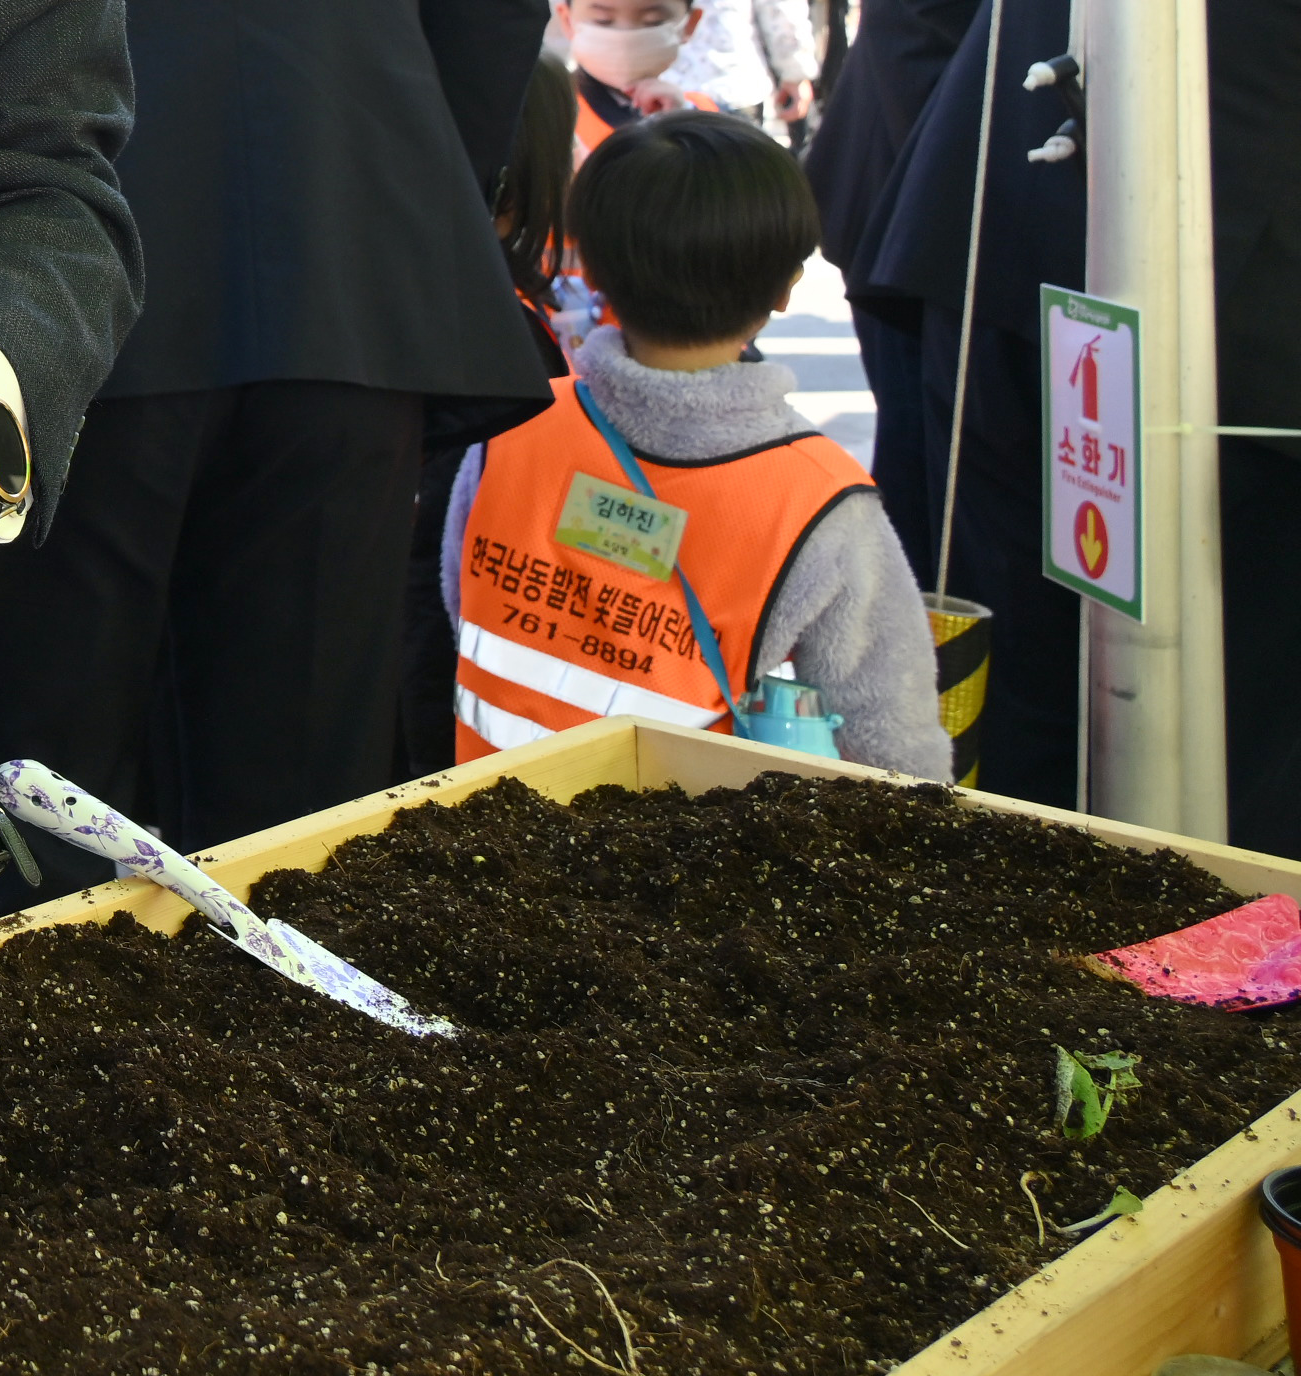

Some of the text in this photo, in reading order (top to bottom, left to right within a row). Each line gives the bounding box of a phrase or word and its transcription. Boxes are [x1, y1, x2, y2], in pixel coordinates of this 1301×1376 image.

[1057, 426, 1126, 488] 소화기
[596, 495, 655, 535] 김하진
[469, 534, 723, 666] 한국남동발전 빛뜰어린이
[502, 603, 654, 674] 761-8894
